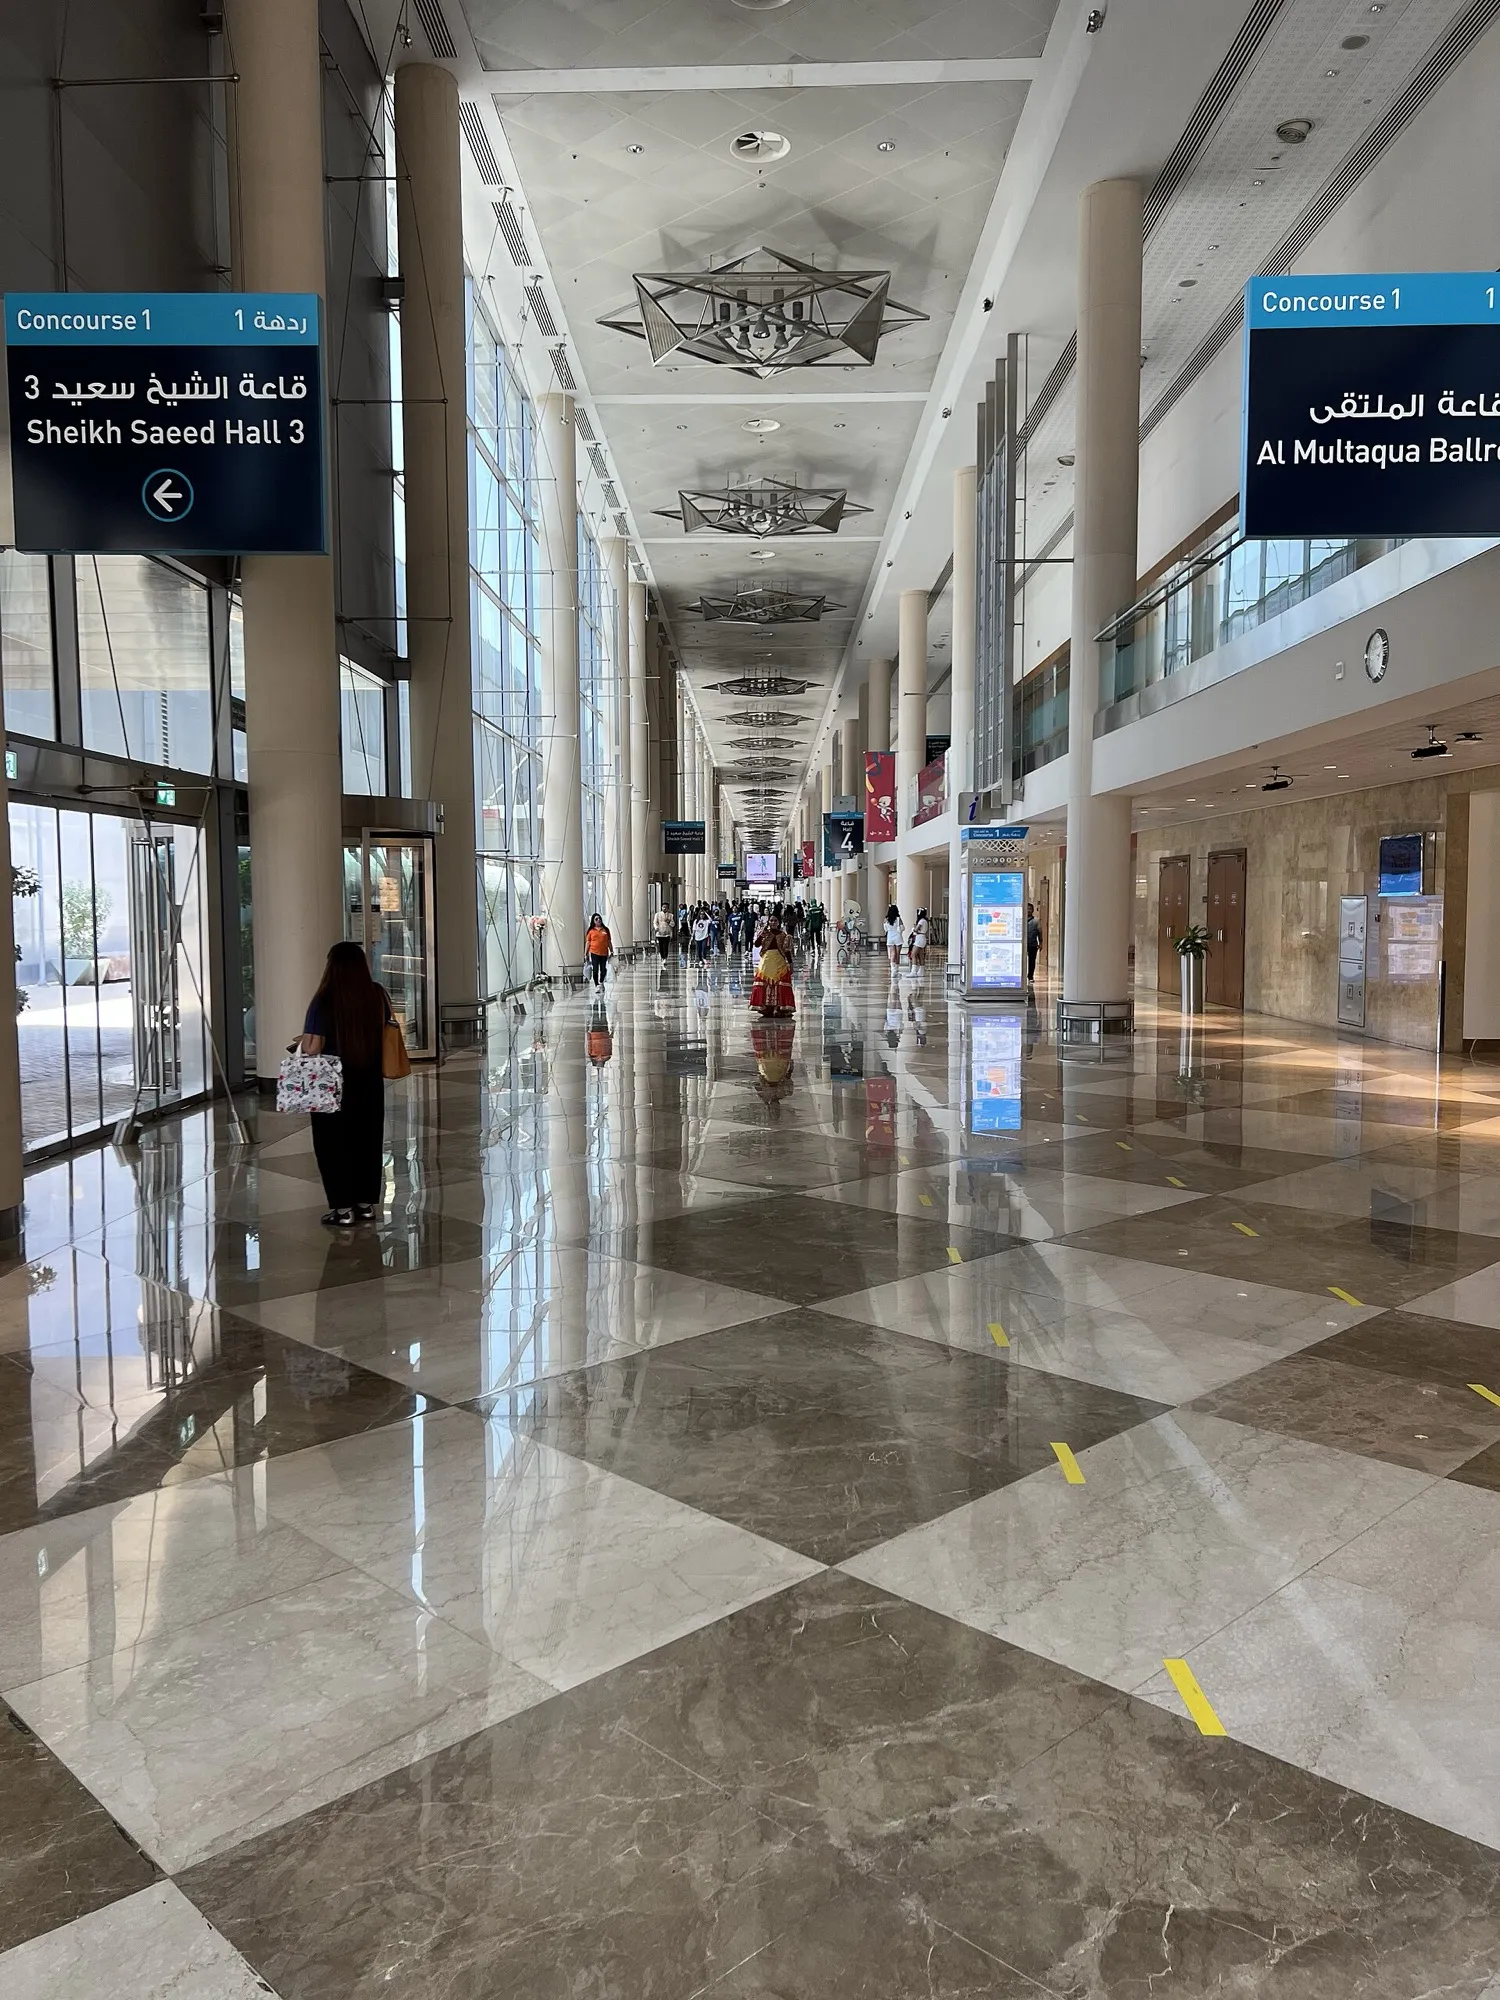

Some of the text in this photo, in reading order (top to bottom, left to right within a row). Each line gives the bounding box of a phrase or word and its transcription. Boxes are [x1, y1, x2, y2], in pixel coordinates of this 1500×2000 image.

[1263, 288, 1400, 313] Concourse 1
[1485, 287, 1494, 309] 1
[17, 308, 151, 330] Concourse 1
[234, 309, 308, 335] ردهة 1
[24, 370, 307, 407] قاعة الشيخ سعيد 3
[1309, 391, 1424, 424] الملتقى
[27, 419, 305, 445] Sheikh Saeed Hall 3
[1256, 437, 1500, 470] Al Multaqua Ballr
[840, 832, 854, 852] 4
[994, 829, 1000, 837] 1
[797, 868, 804, 878] 3
